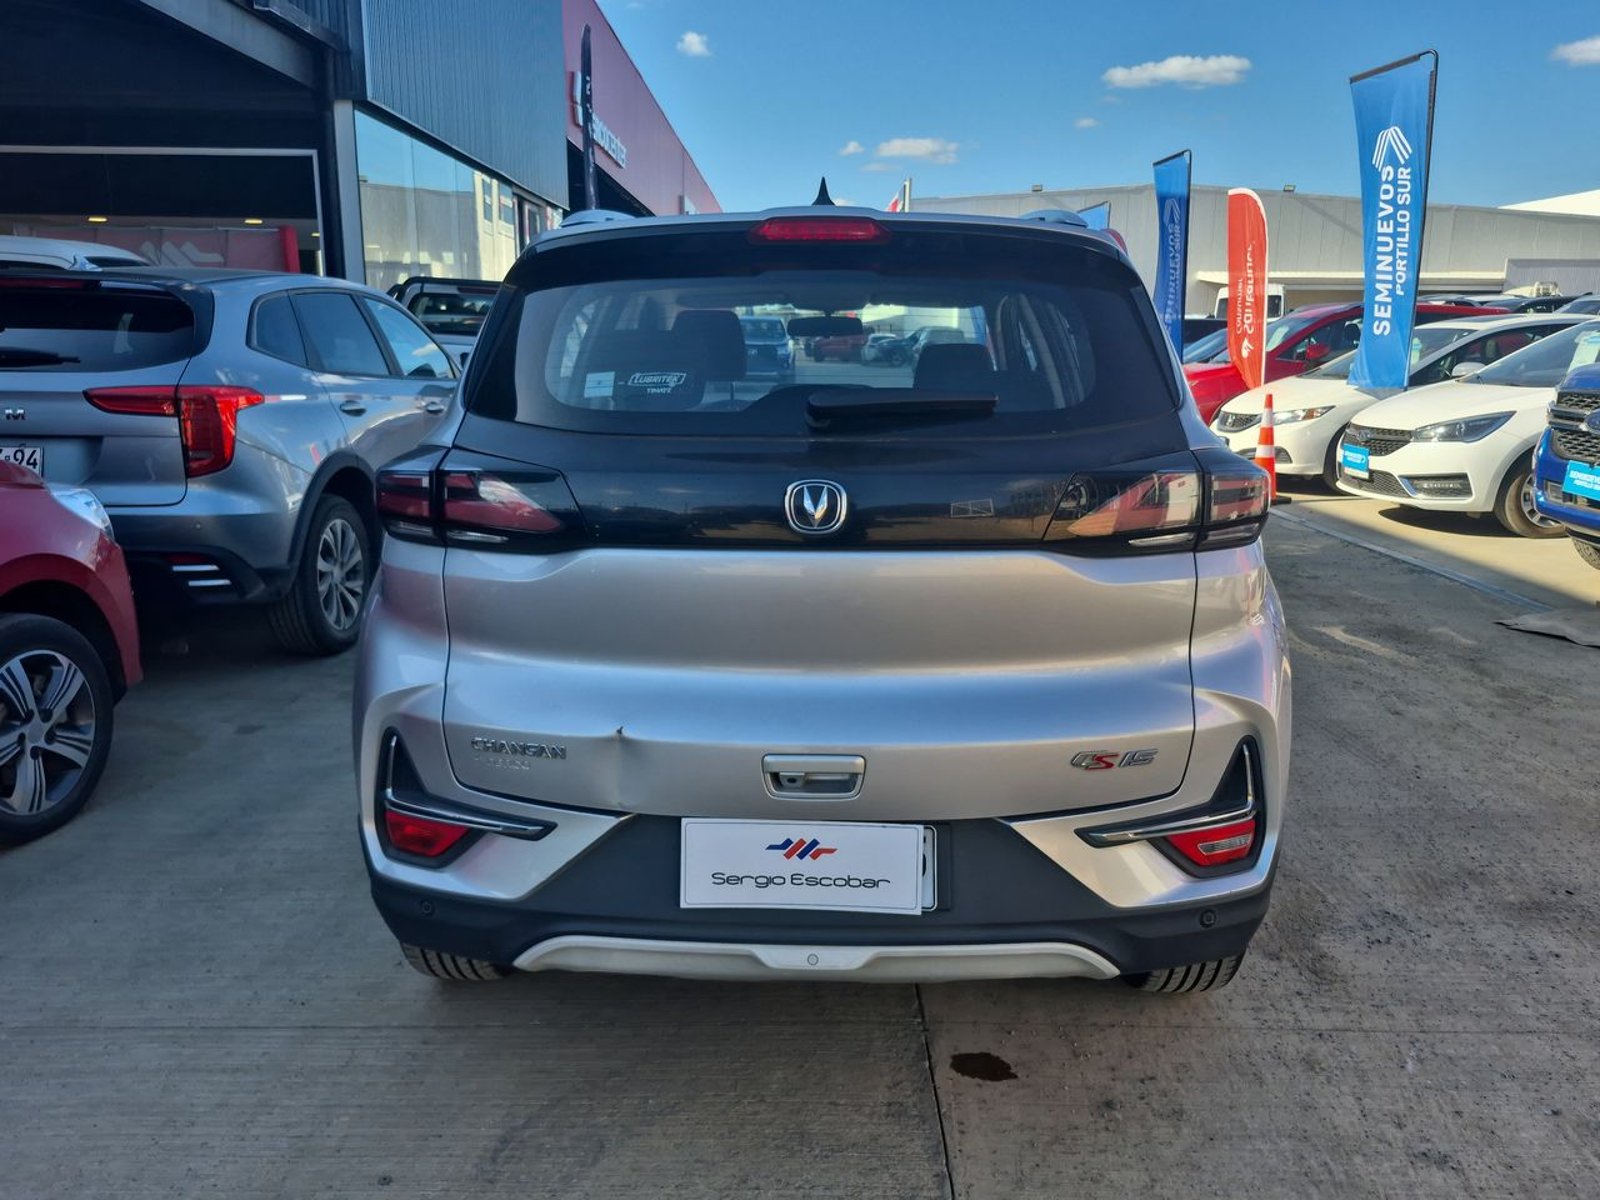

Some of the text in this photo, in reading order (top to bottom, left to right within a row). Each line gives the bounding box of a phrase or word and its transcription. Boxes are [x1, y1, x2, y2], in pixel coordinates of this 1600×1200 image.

[1373, 165, 1395, 336] SEMINUEVOS
[1396, 167, 1412, 296] PORTILLO SUR
[471, 736, 567, 759] CHANGAN
[711, 872, 891, 889] Sergio Escobar
